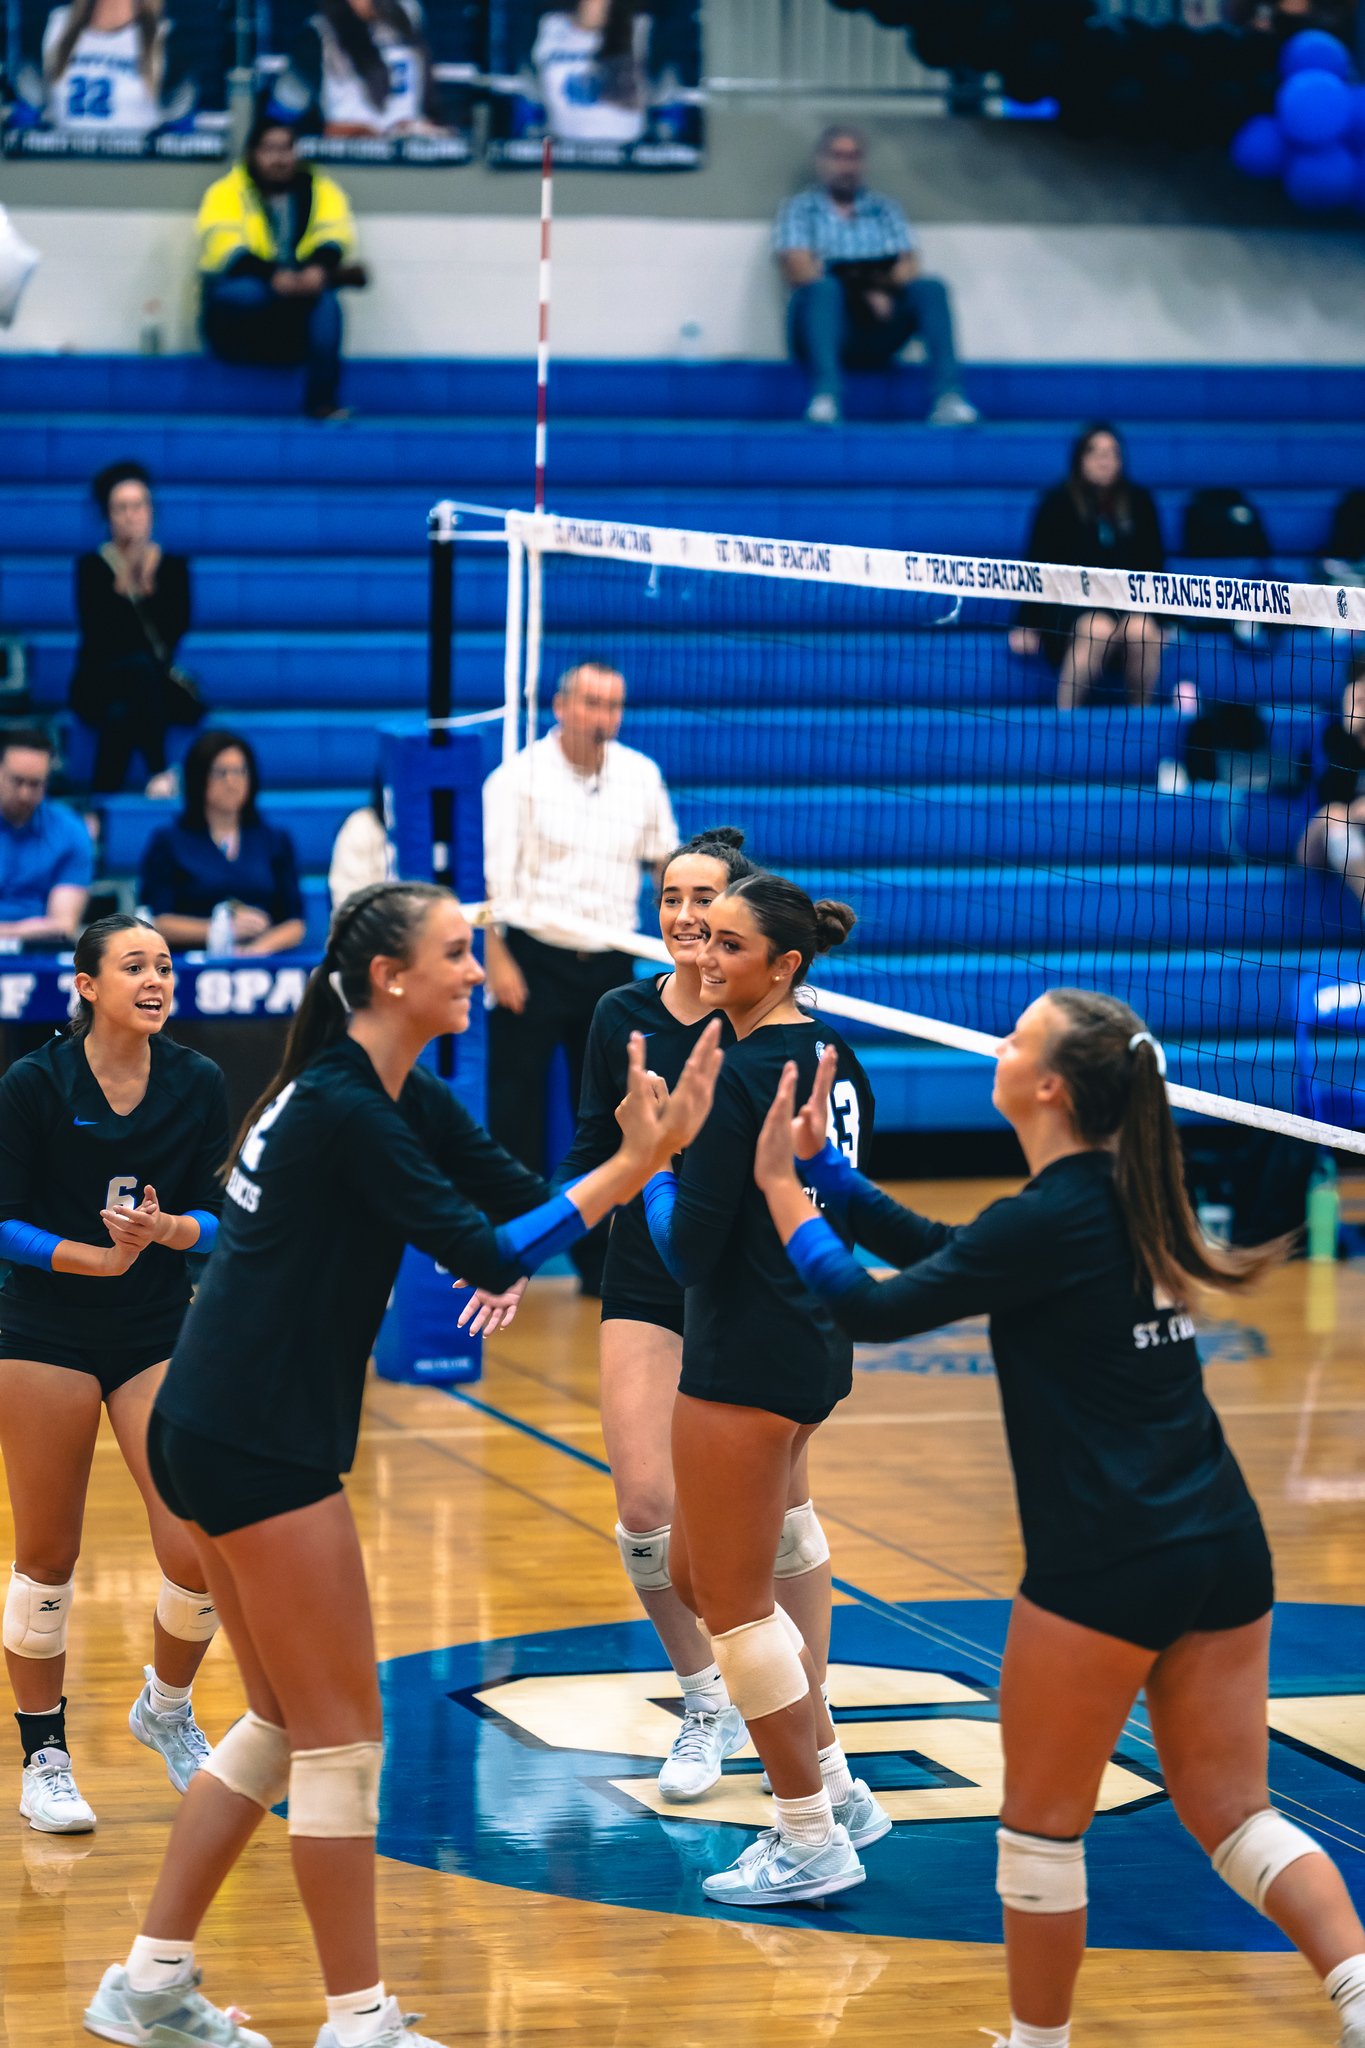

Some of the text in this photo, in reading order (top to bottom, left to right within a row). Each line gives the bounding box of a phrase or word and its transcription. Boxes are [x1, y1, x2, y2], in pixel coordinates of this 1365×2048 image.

[905, 555, 1044, 594] ST. FRANCIS SPARTANS
[1127, 573, 1292, 615] ST. FRANCIS SPARTANS
[195, 969, 306, 1015] SPA
[106, 1176, 138, 1221] 6
